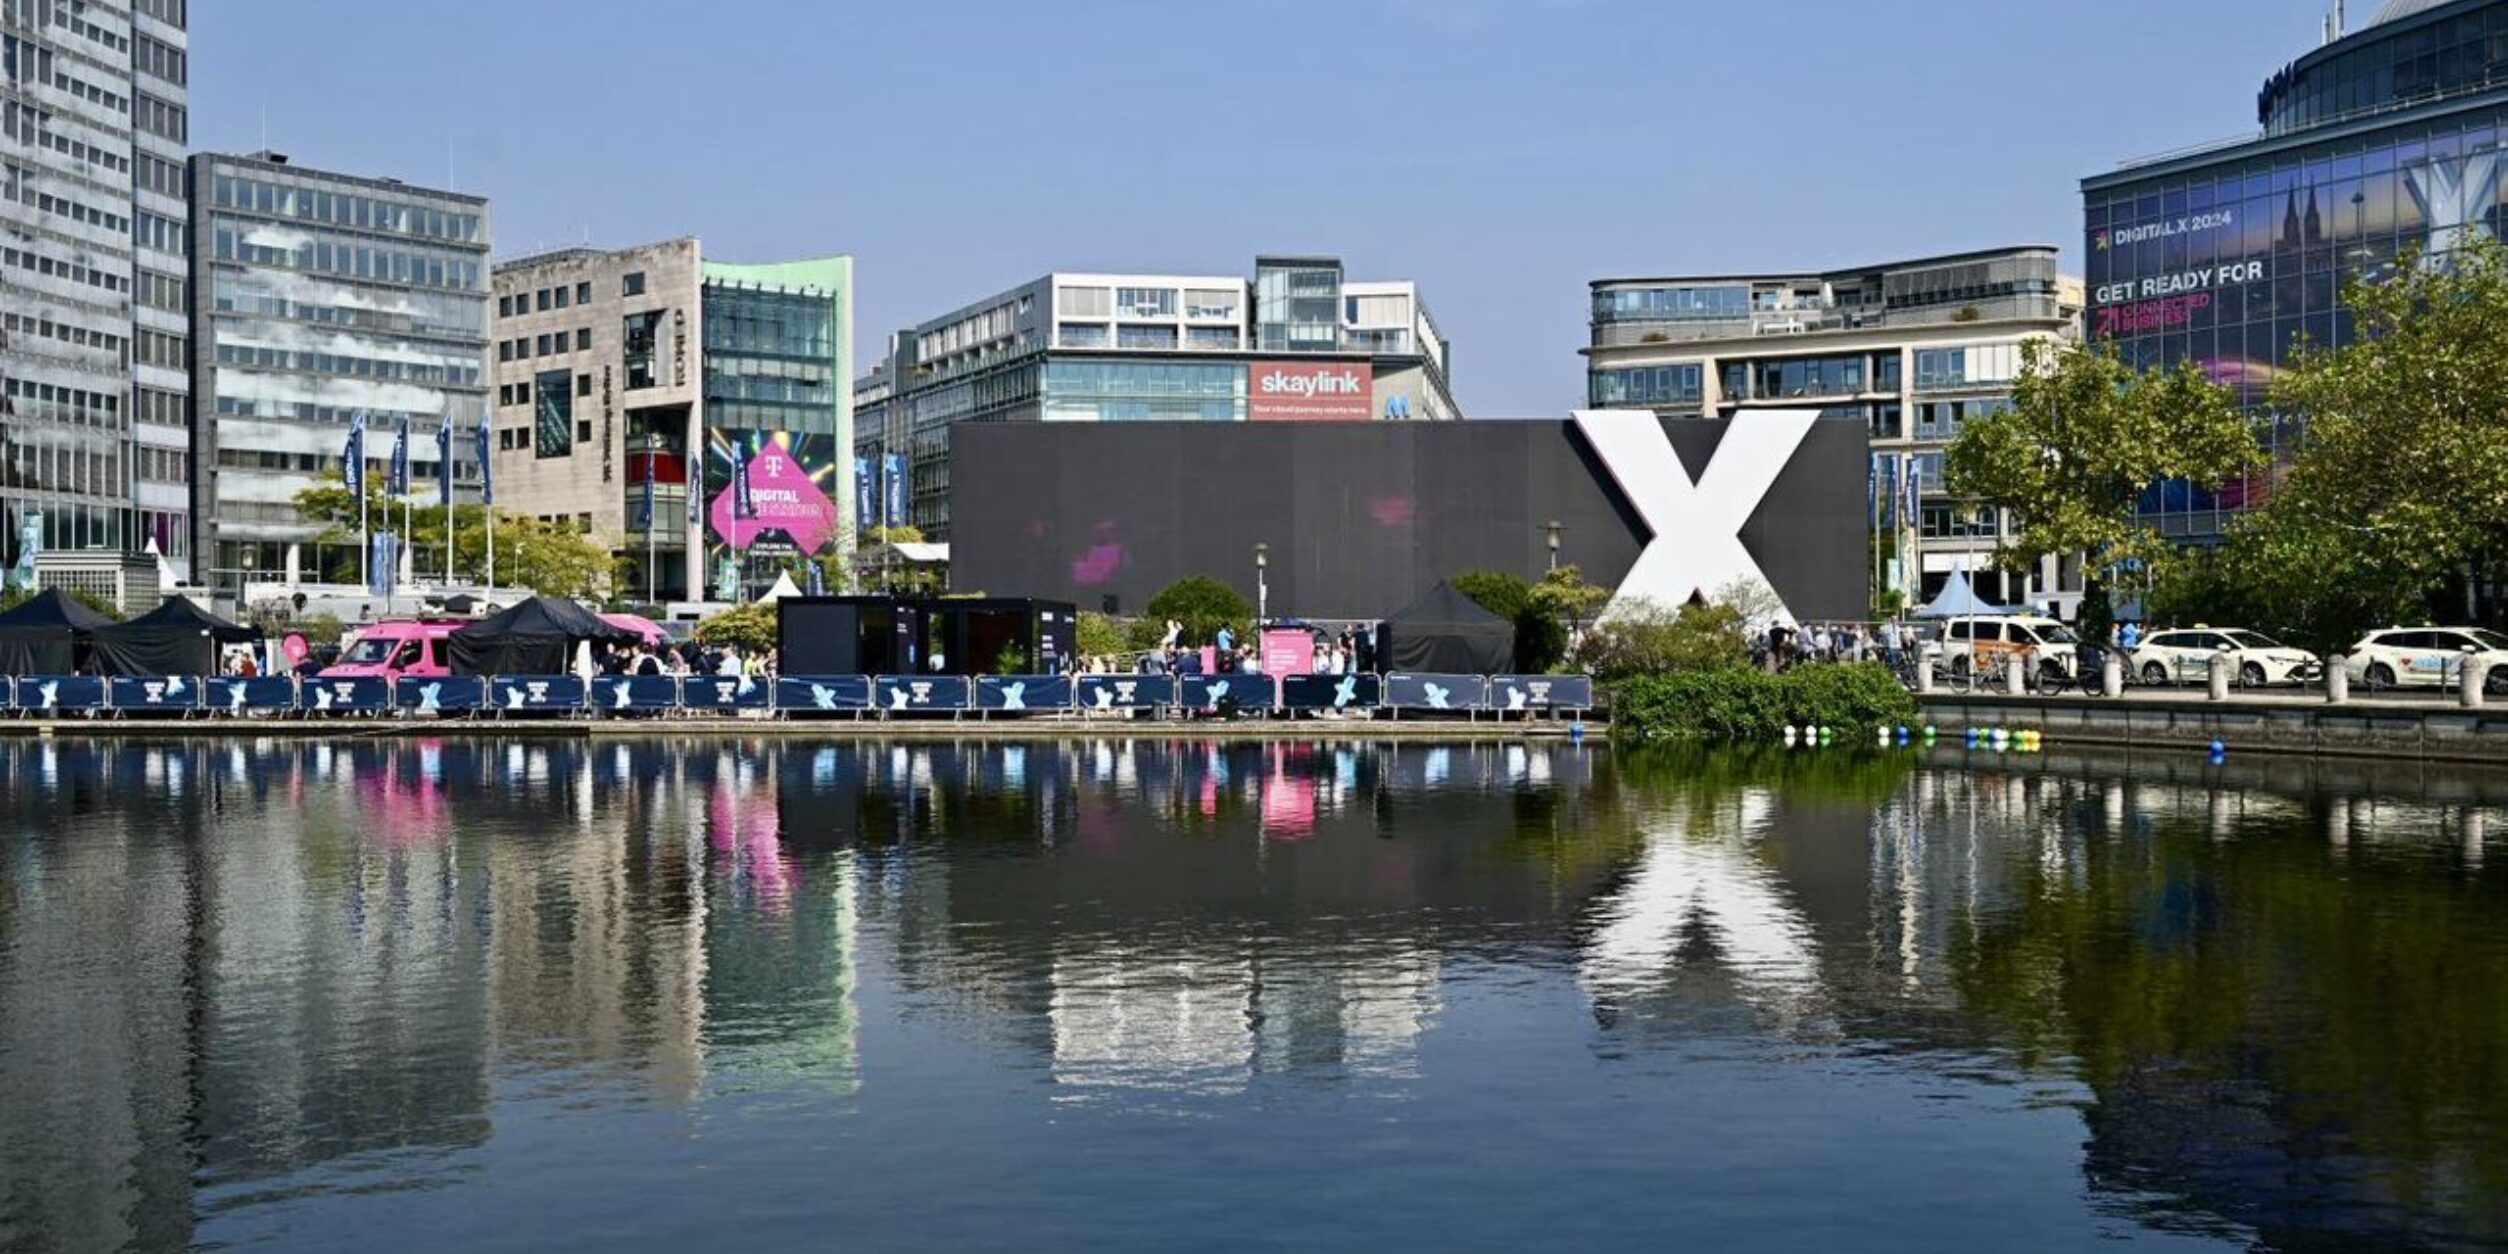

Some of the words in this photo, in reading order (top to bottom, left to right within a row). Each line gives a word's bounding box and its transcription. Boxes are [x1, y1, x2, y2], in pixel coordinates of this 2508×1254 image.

[2115, 220, 2175, 245] DIGITAL
[2177, 218, 2189, 233] X
[2192, 210, 2232, 231] 2024
[2096, 282, 2136, 304] GET
[2142, 268, 2212, 296] READY
[2219, 260, 2263, 285] FOR
[2123, 293, 2210, 317] CONNECTED
[2123, 309, 2193, 331] BUSINESS
[1261, 370, 1361, 397] skaylink
[765, 455, 783, 477] T
[750, 488, 799, 503] DIGITAL
[1572, 409, 1822, 632] X
